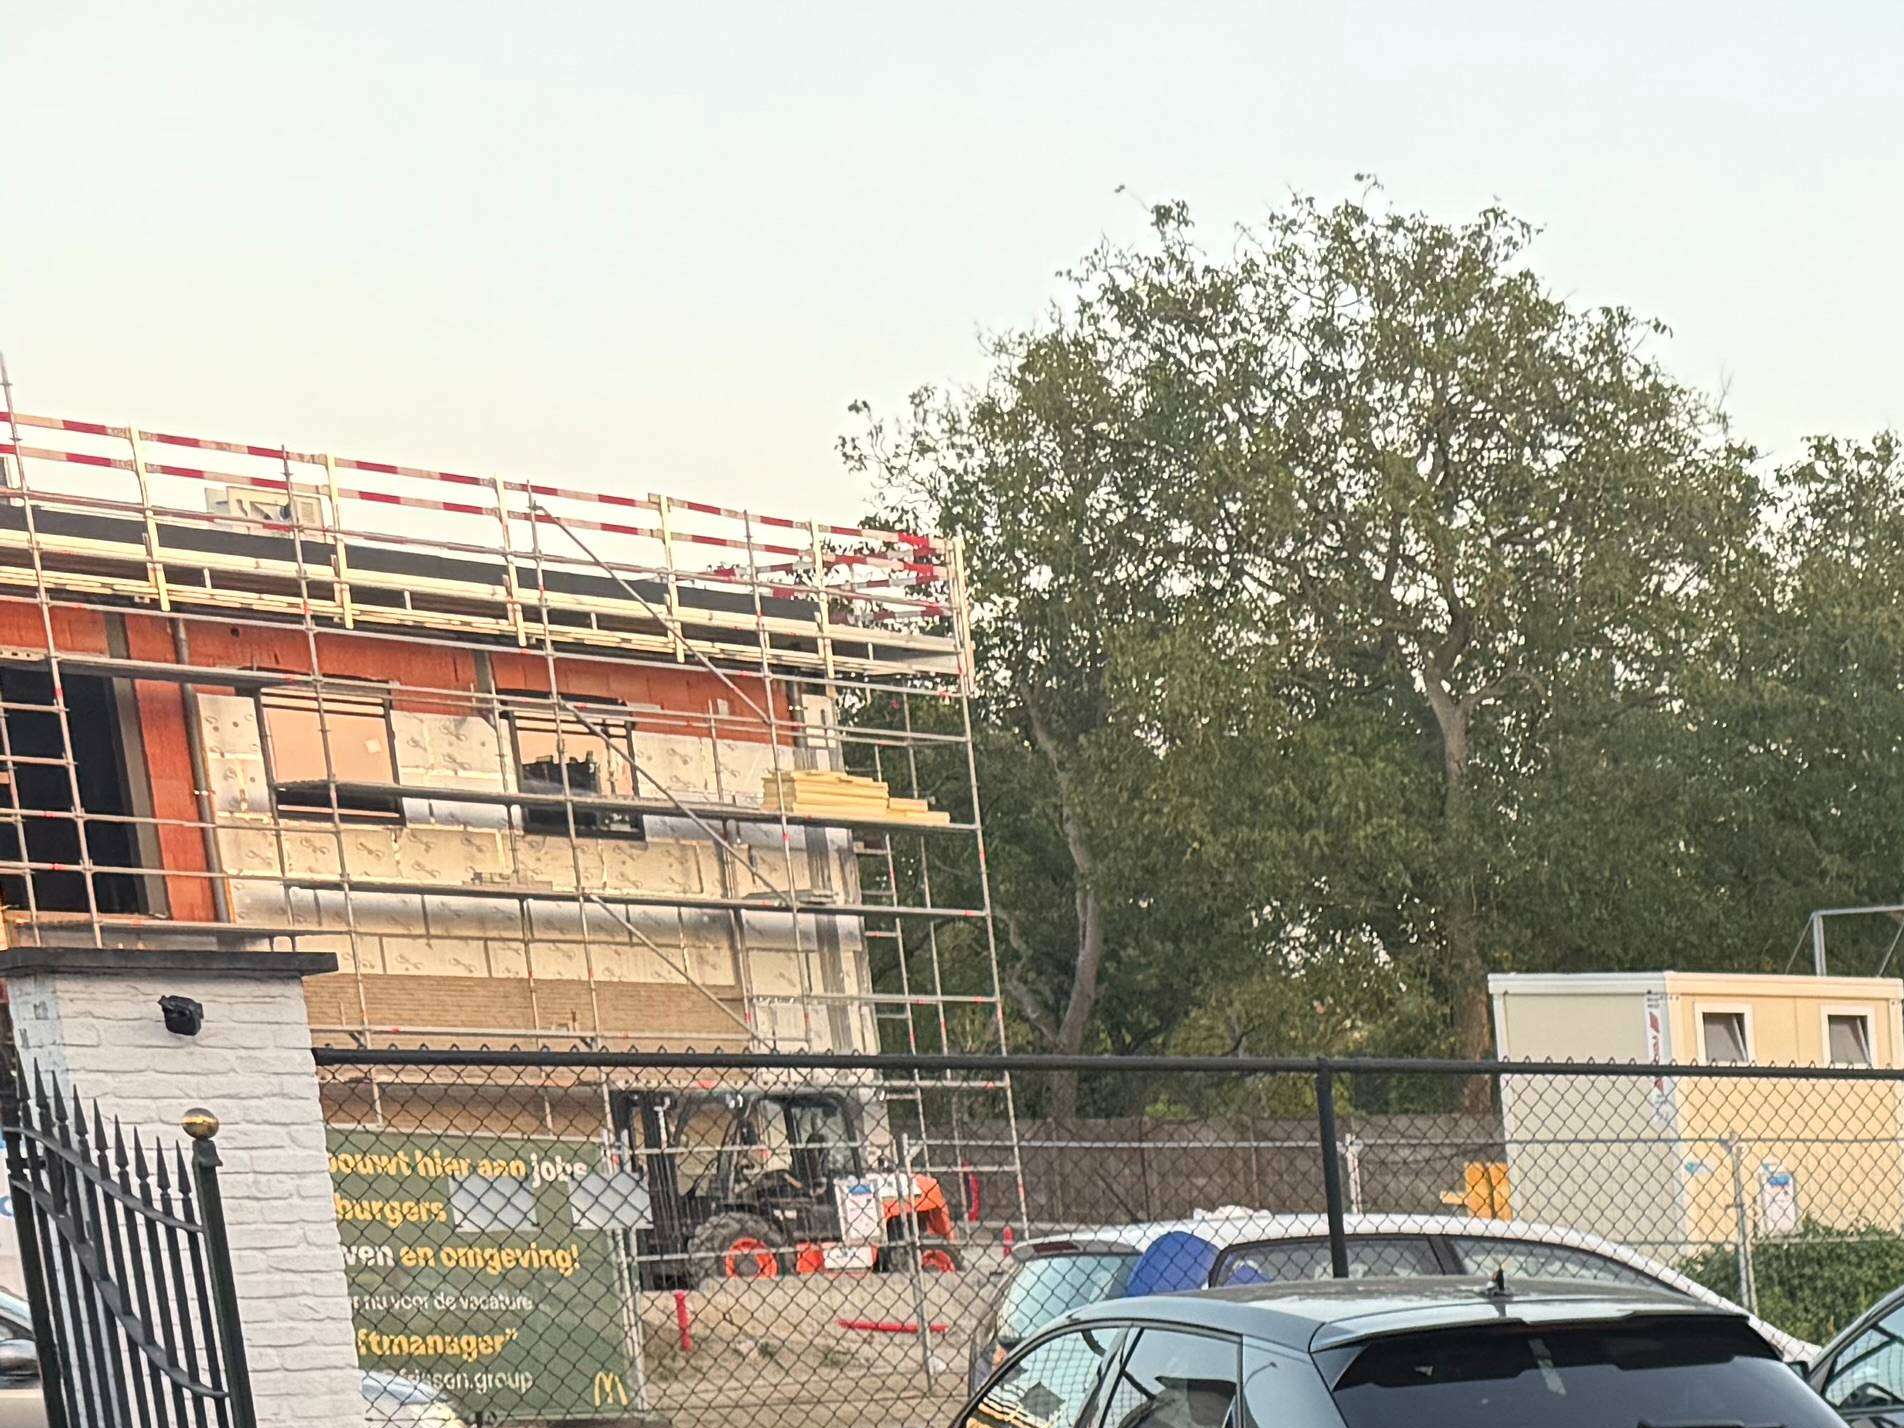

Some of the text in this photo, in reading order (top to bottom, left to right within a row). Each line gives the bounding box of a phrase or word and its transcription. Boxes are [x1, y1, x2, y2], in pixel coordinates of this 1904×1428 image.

[414, 1148, 472, 1177] hier
[477, 1157, 527, 1178] aan
[334, 1194, 448, 1227] burgers
[400, 1244, 437, 1269] en
[440, 1242, 582, 1277] omgeving!
[433, 1292, 457, 1311] de
